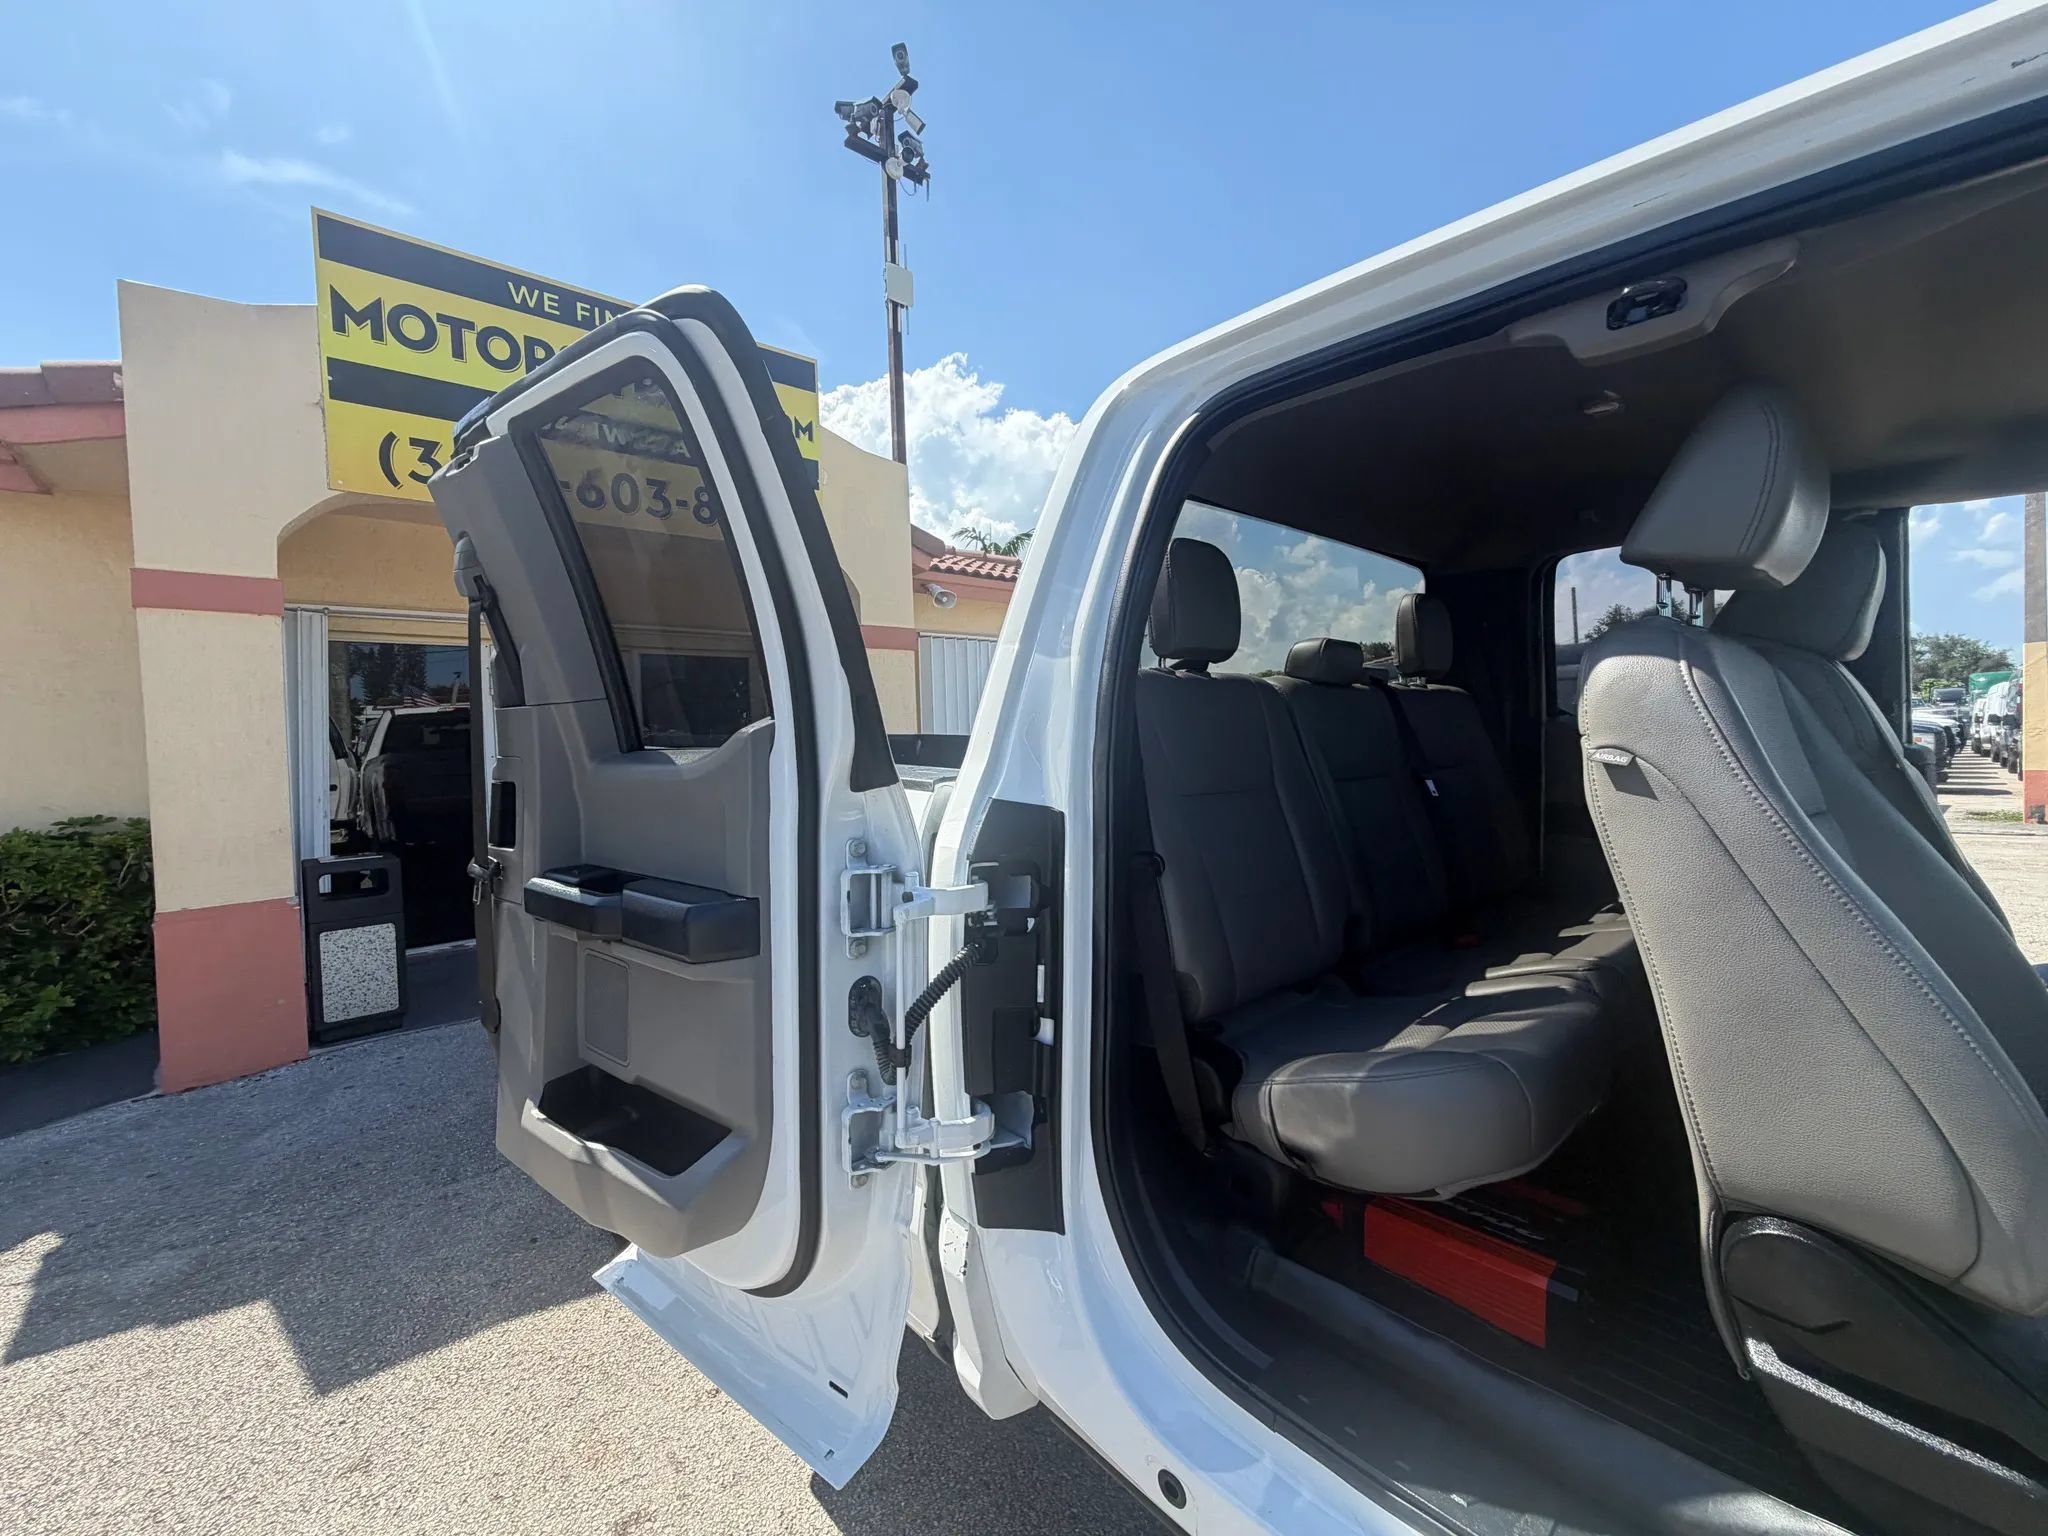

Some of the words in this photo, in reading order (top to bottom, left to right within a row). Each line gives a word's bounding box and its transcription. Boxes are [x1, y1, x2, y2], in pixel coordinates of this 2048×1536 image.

[330, 283, 567, 376] MOTOR
[507, 281, 561, 316] WE
[378, 431, 444, 490] (3
[559, 469, 718, 526] -603-8
[1594, 752, 1629, 763] AIRBAG
